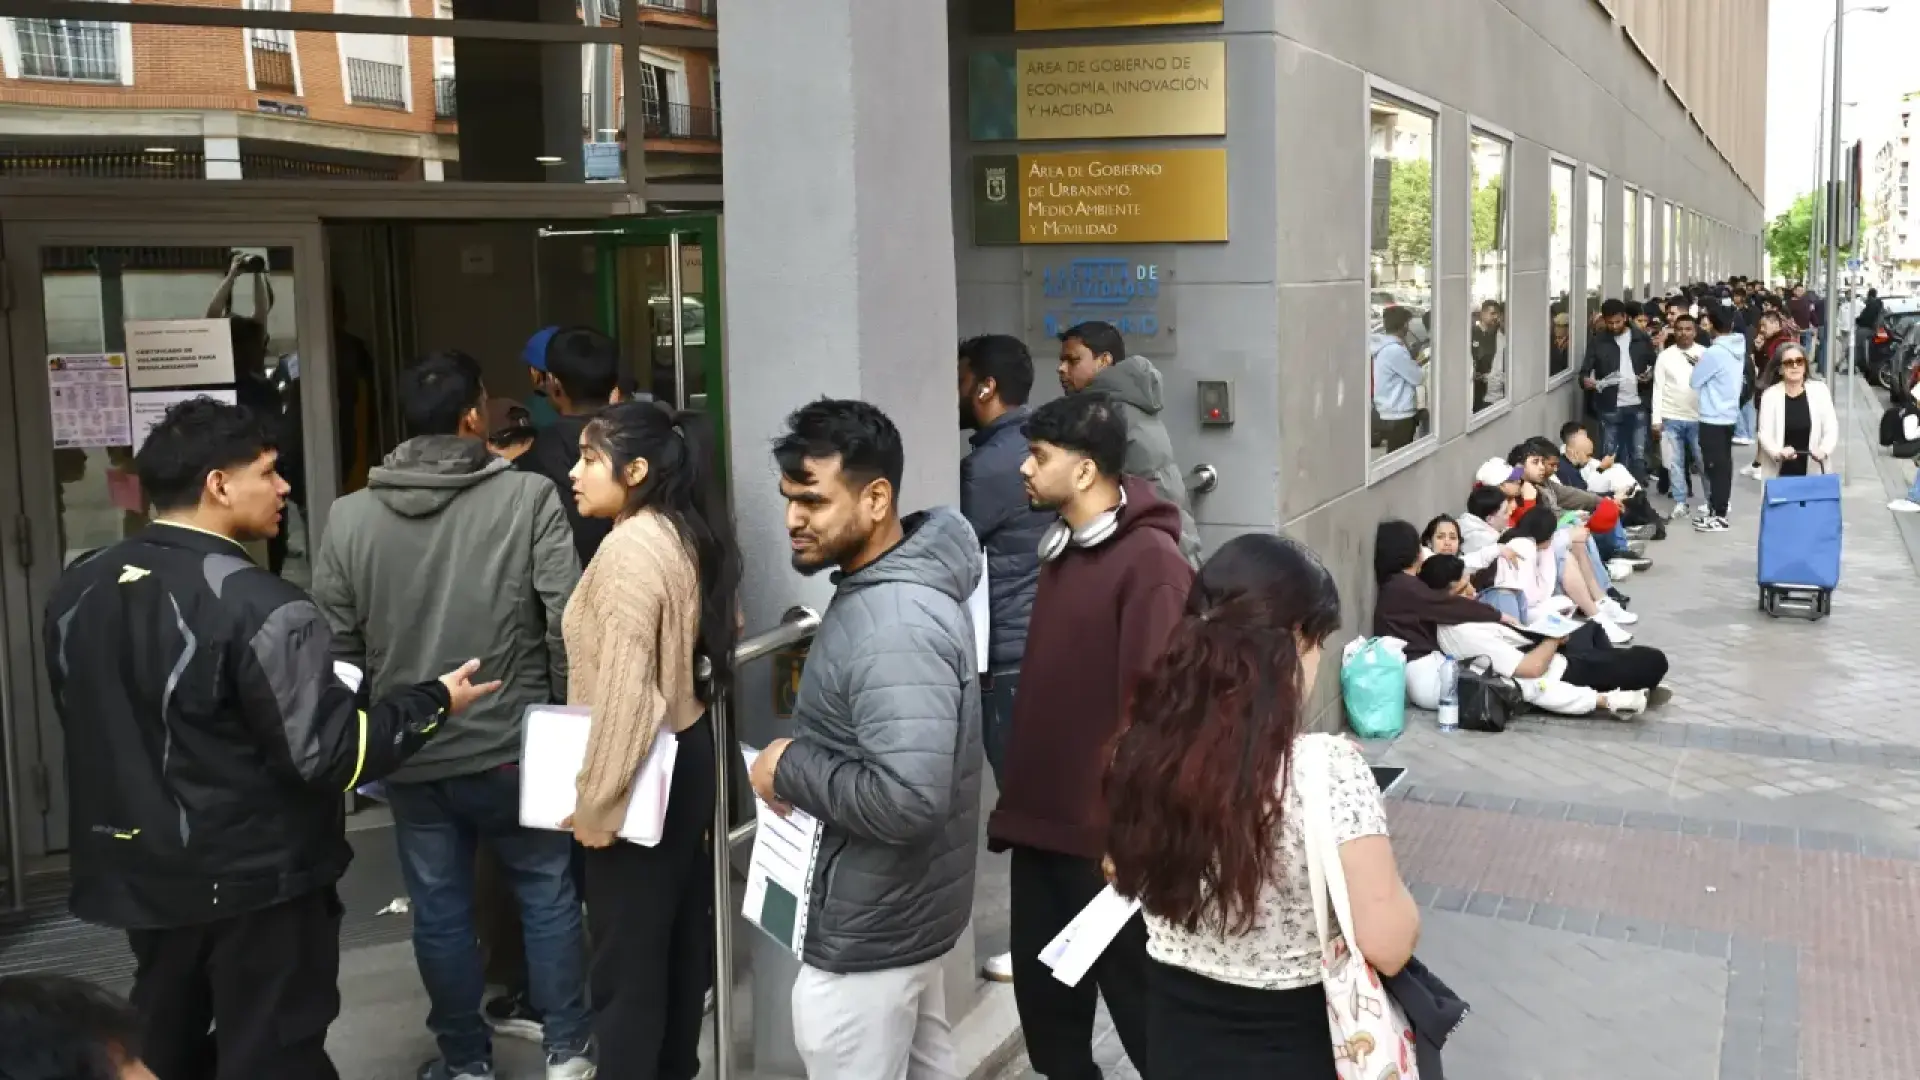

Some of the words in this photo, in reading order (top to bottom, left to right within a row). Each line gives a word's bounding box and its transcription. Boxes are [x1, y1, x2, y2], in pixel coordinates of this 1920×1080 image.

[1067, 60, 1085, 73] DE
[1090, 58, 1166, 73] GOBIERNO
[1172, 56, 1191, 70] DE
[1028, 106, 1036, 117] Y
[1040, 102, 1114, 117] HACIENDA
[1068, 165, 1084, 177] DE
[1088, 162, 1162, 177] GOBIERNO
[1028, 186, 1044, 198] DE
[1028, 202, 1073, 217] MEDIO
[1075, 201, 1141, 216] AMBIENTE
[1043, 221, 1118, 236] MOVILIDAD
[1136, 265, 1159, 280] DE
